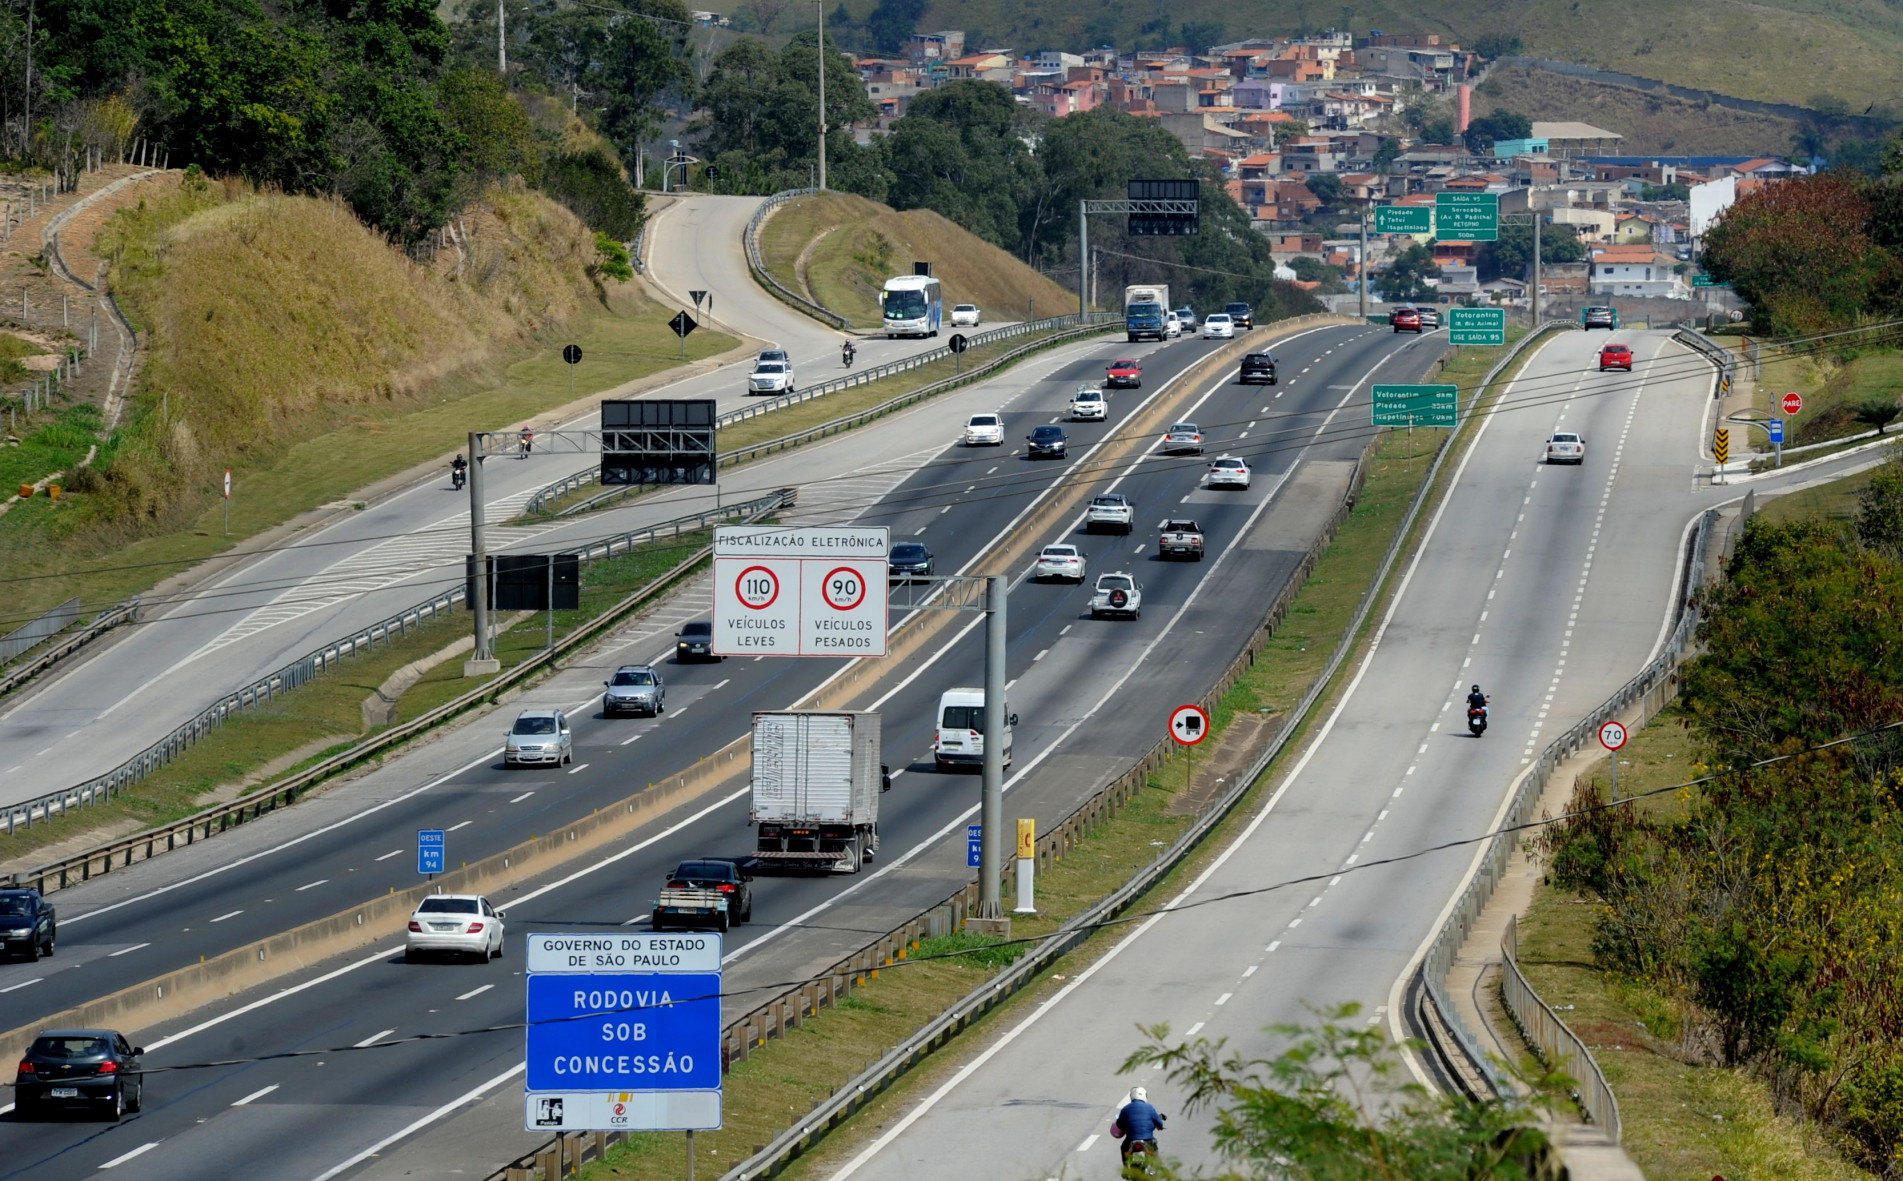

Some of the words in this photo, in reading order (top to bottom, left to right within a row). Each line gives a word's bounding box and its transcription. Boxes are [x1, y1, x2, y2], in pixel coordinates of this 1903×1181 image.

[1468, 333, 1487, 341] SAÍDA
[812, 535, 884, 548] ELETRÔNICA
[746, 579, 771, 595] 110
[832, 579, 856, 595] 90
[728, 616, 786, 630] VEÍCULOS
[815, 617, 873, 631] VEÍCULOS
[737, 636, 775, 646] LEVES
[815, 637, 871, 648] PESADOS
[1604, 730, 1621, 740] 70
[423, 850, 439, 858] km
[543, 939, 613, 952] GOVERNO
[621, 939, 641, 951] DO
[650, 939, 705, 951] ESTADO
[569, 955, 587, 967] DE
[595, 953, 625, 967] SÃO
[633, 954, 680, 967] PAULO
[574, 990, 674, 1009] RODOVIA
[602, 1022, 647, 1042] SOB
[610, 1116, 628, 1124] CCR
